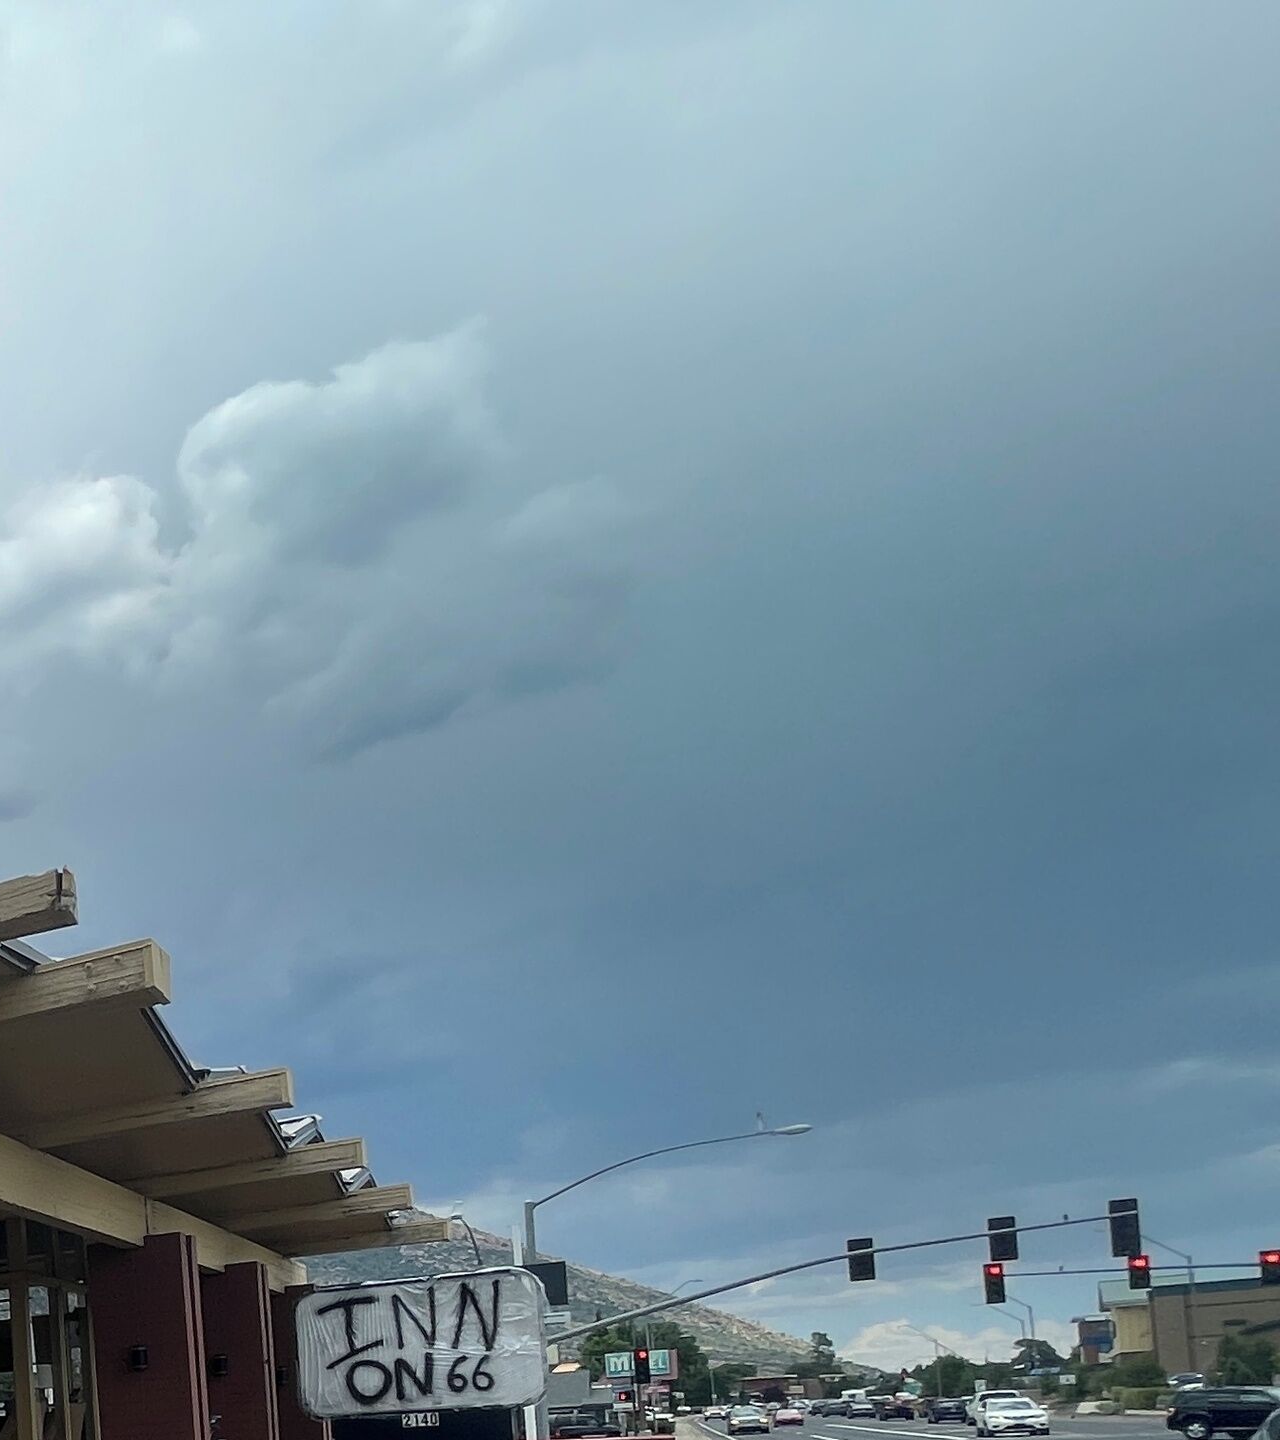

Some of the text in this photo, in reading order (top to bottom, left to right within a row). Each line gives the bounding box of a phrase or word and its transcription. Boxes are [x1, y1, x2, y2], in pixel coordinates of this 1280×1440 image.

[318, 1280, 500, 1368] INN
[346, 1352, 494, 1404] ON 66
[609, 1351, 666, 1371] MEL
[403, 1413, 438, 1427] 2140
